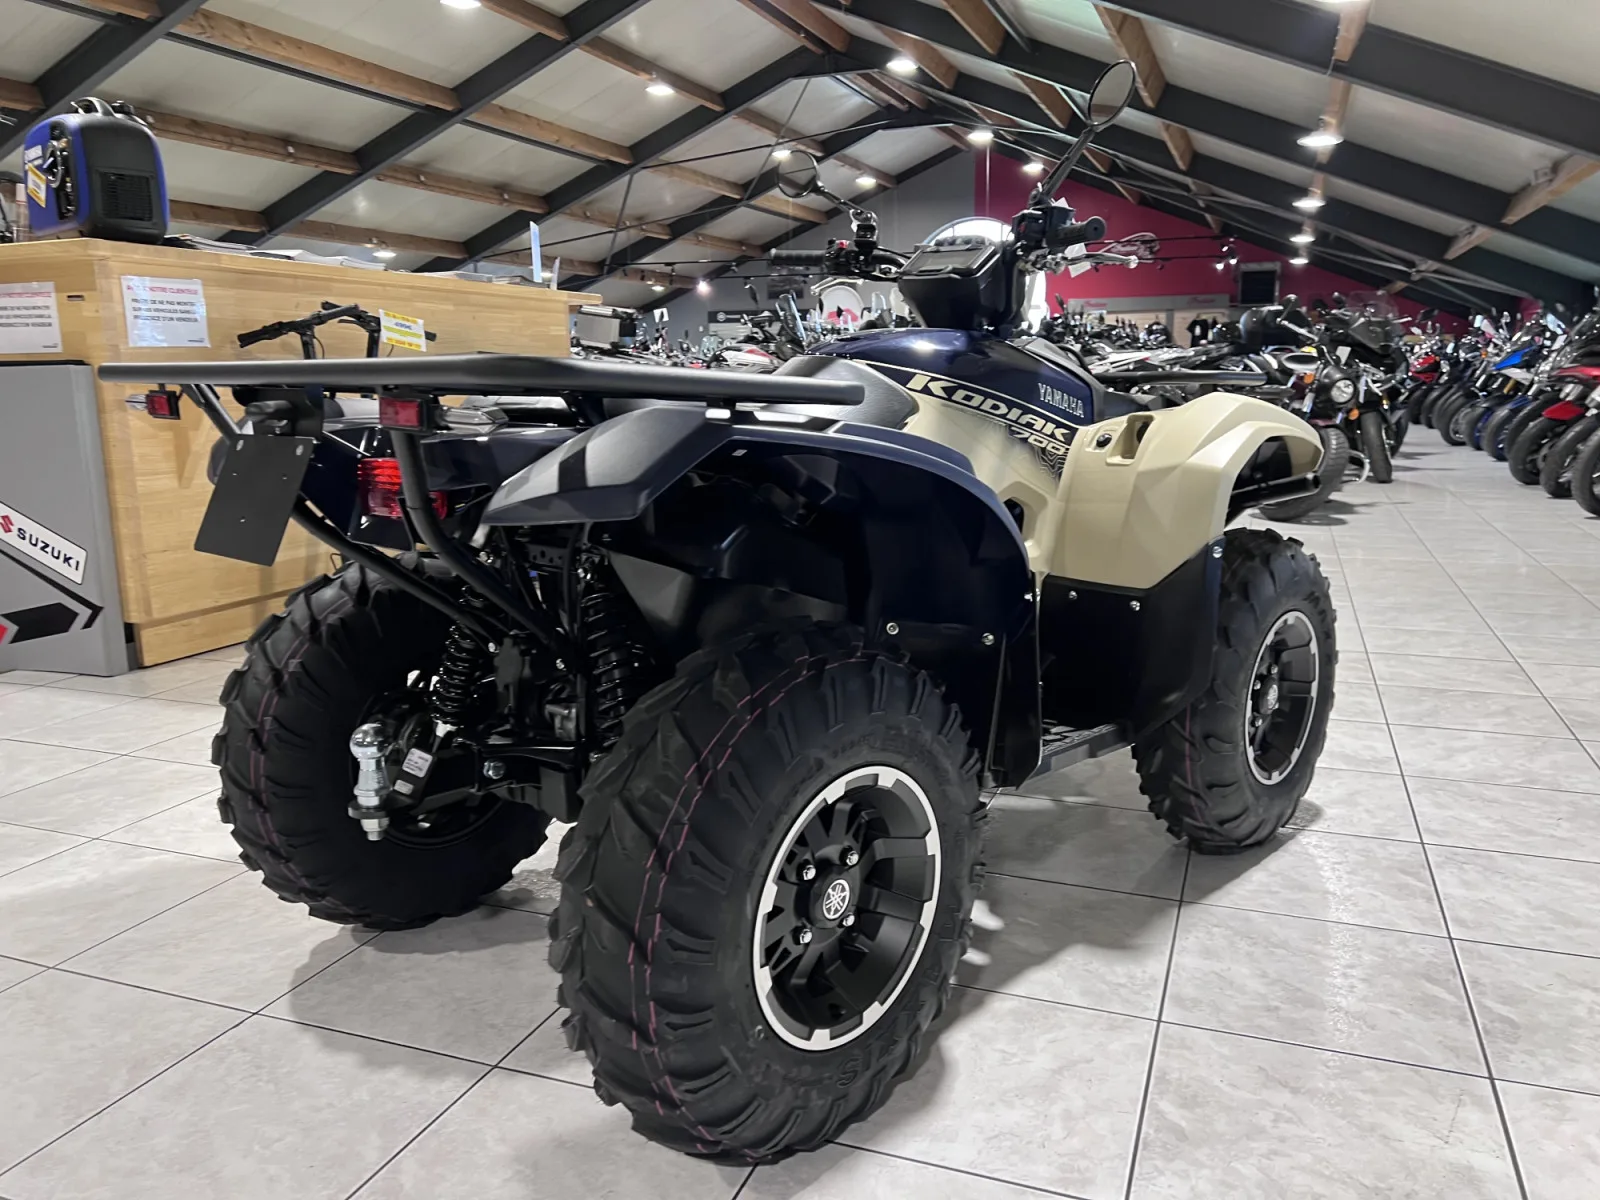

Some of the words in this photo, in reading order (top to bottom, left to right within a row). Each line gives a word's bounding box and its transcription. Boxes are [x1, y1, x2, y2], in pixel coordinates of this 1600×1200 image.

[905, 373, 1072, 442] KODIAK
[1038, 382, 1085, 418] YAMAHA
[1010, 426, 1066, 455] 700
[17, 527, 80, 572] SUZUKI
